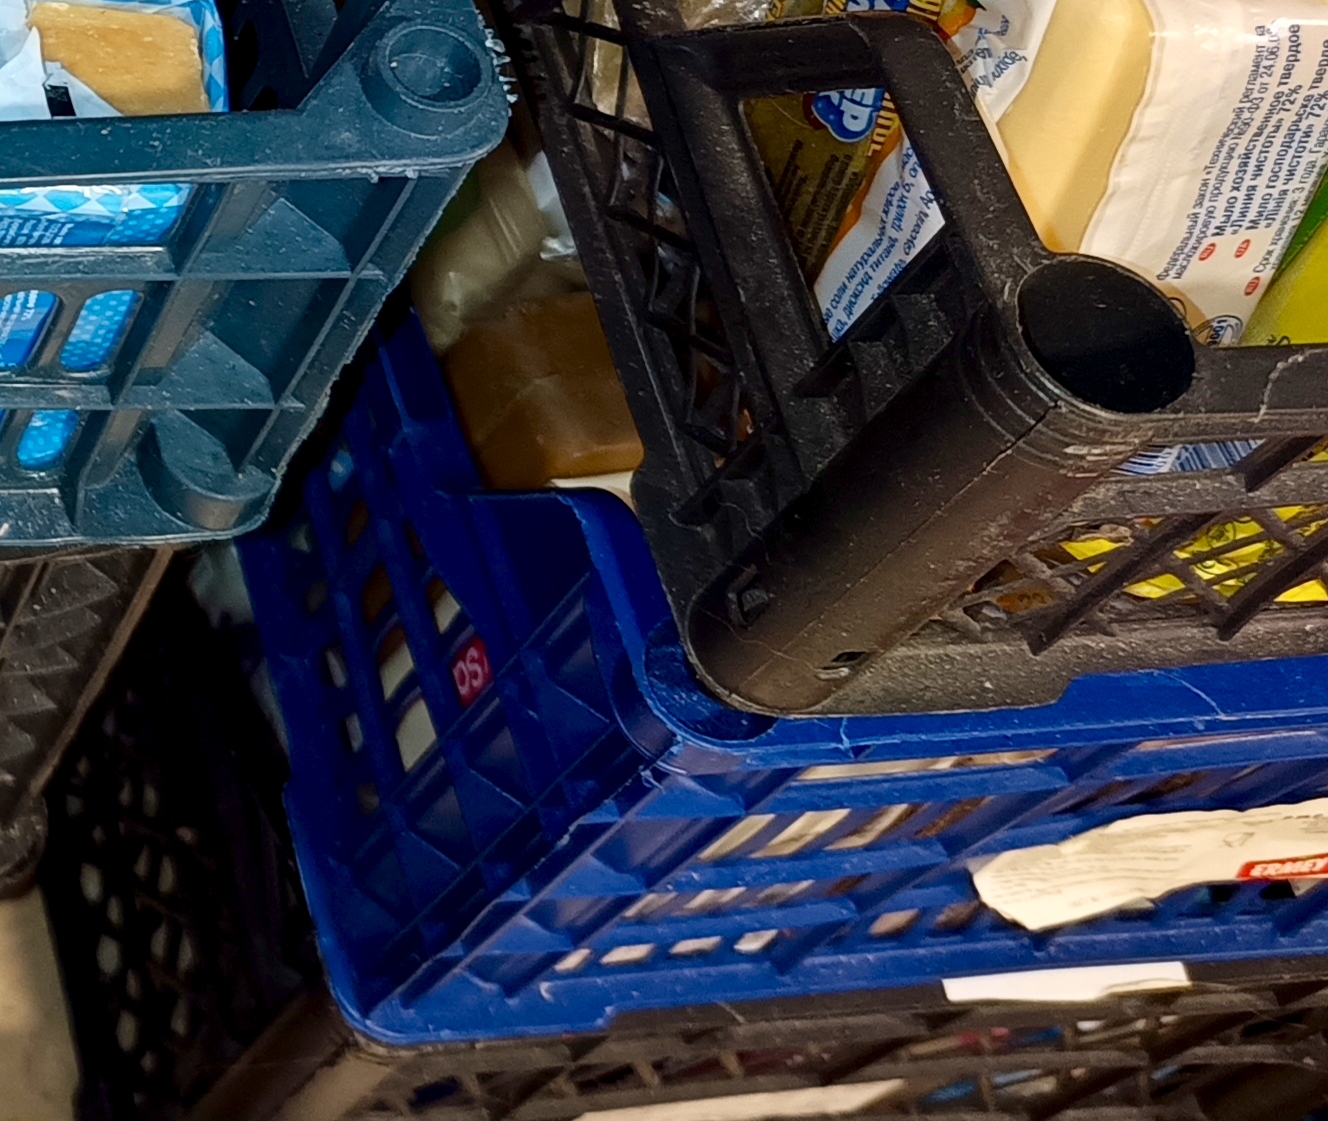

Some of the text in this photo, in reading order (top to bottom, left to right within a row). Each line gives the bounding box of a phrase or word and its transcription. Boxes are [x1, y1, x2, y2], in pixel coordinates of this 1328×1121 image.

[1156, 213, 1200, 281] Федеральный
[1192, 177, 1210, 210] закон
[1239, 44, 1266, 104] регламент
[1210, 142, 1239, 204] продукцию
[1257, 80, 1270, 94] от
[1211, 24, 1302, 237] Мыло хозяйственное твердое
[1231, 84, 1303, 235] «Линия чистоты» 72%
[1245, 191, 1271, 231] Мило
[1266, 94, 1314, 190] господарське
[1282, 123, 1315, 185] чистоти»
[1304, 89, 1328, 120] 72%
[831, 281, 849, 312] соли
[842, 270, 873, 318] диоксид
[1252, 244, 1275, 274] Срок
